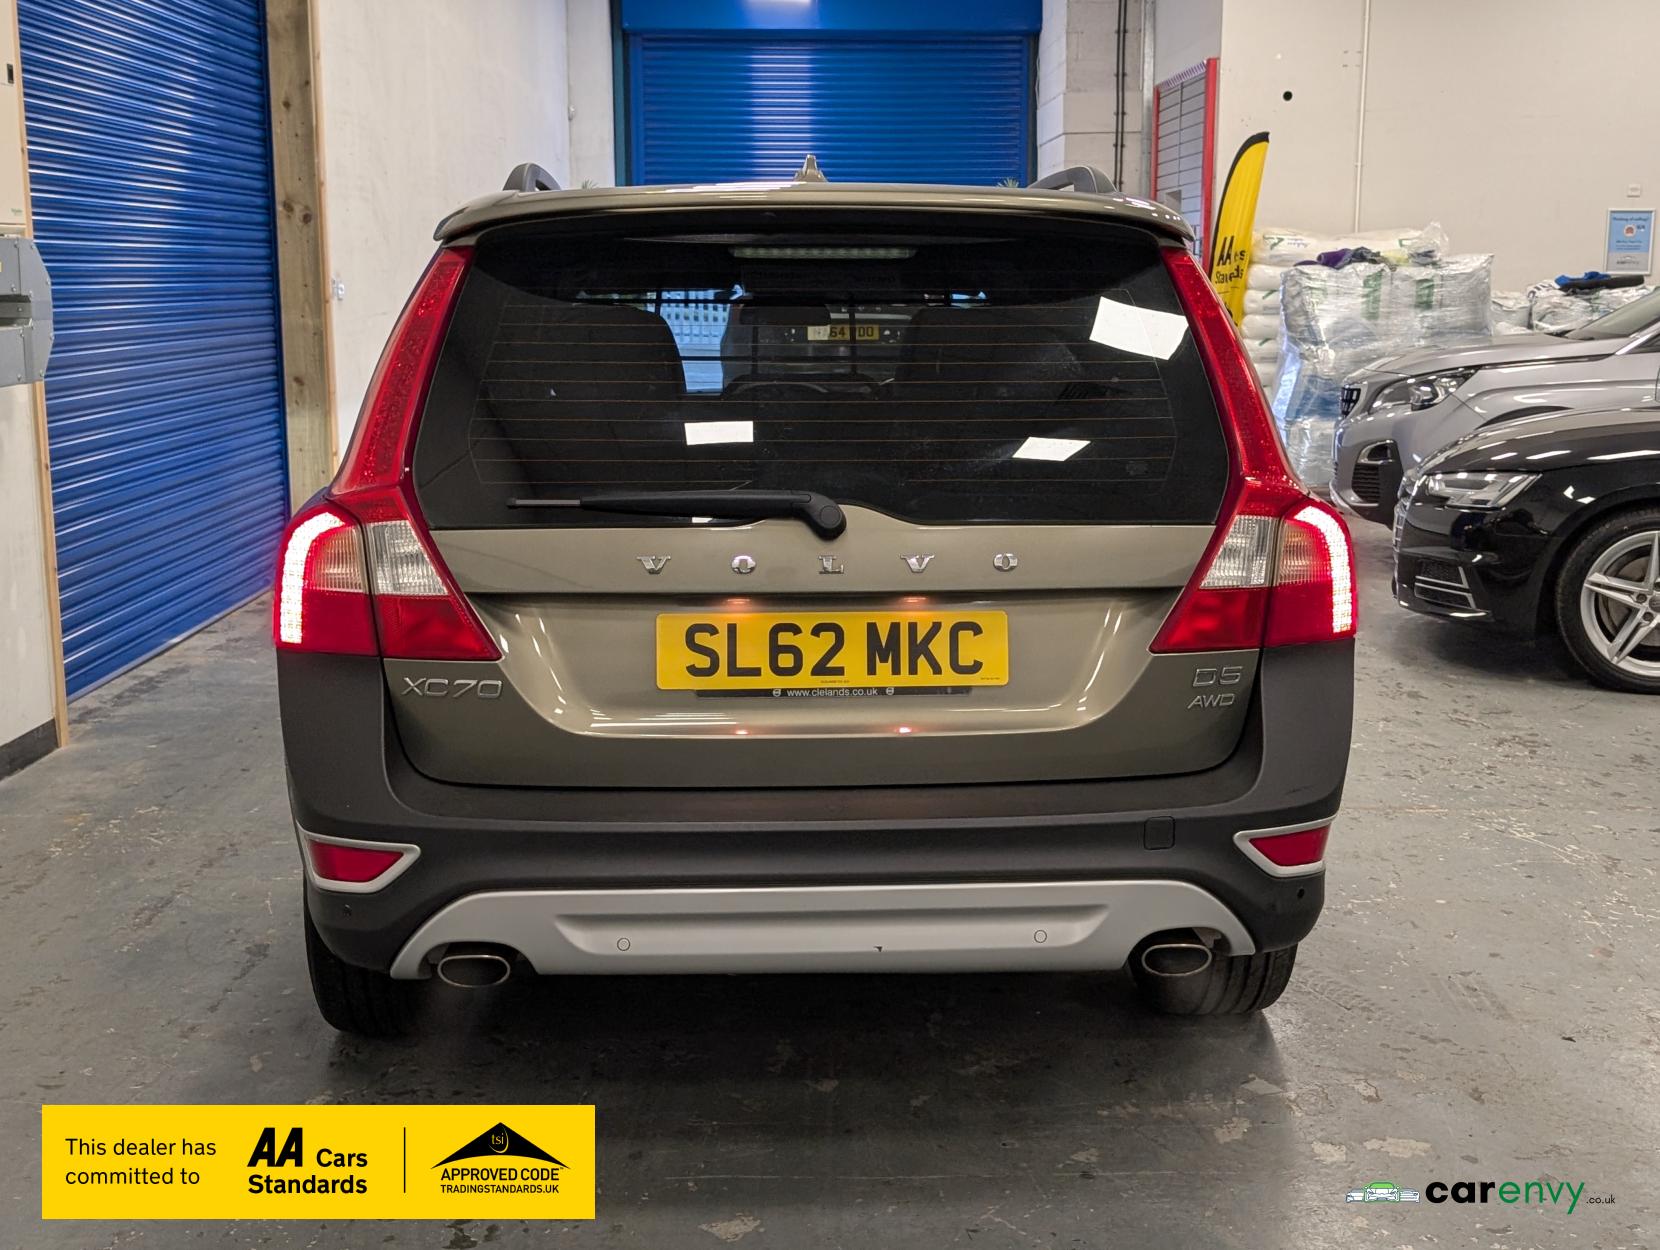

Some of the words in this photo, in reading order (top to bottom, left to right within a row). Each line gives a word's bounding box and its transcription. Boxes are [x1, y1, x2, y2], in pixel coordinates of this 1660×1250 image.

[1217, 236, 1234, 266] AA
[640, 553, 1019, 574] VOLVO
[686, 622, 845, 677] SL62
[866, 621, 984, 676] MKC
[1193, 666, 1243, 687] D5
[401, 677, 503, 699] XC70
[786, 687, 878, 698] www.clelands.co.uk
[1187, 693, 1236, 709] AWD
